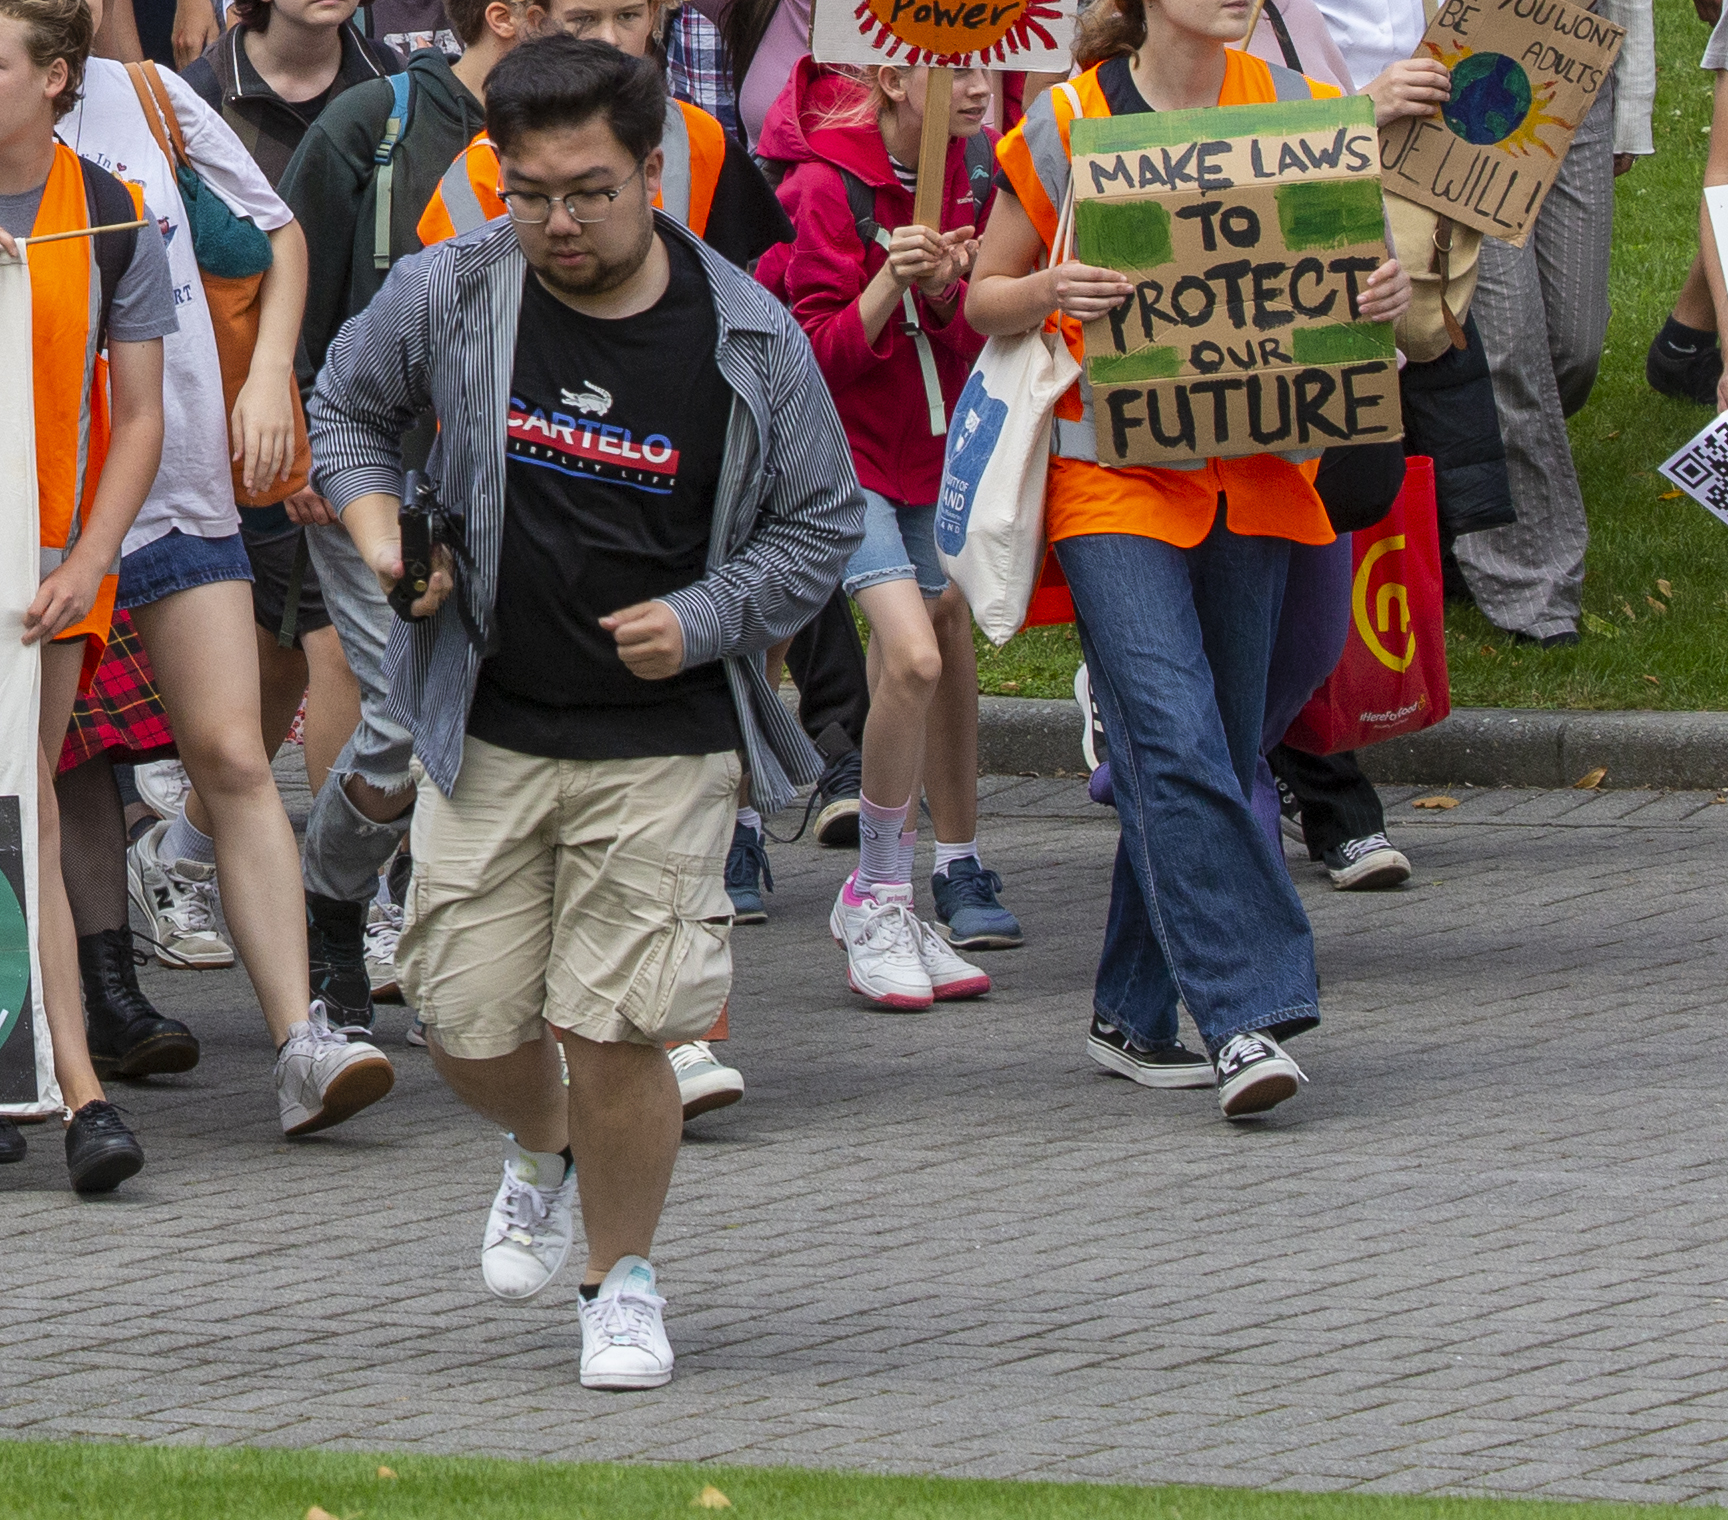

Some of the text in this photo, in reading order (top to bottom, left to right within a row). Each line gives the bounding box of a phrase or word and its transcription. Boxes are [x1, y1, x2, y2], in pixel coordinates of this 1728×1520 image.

[1553, 7, 1625, 52] WONT
[1521, 41, 1604, 94] ADULTS
[1089, 127, 1372, 194] MAKE LAWS
[1175, 200, 1261, 252] TO
[1108, 256, 1380, 354] PROTECT
[1190, 337, 1294, 374] OUR
[506, 396, 674, 465] CARTELO
[1105, 360, 1389, 459] FUTURE
[622, 469, 676, 487] LIFE
